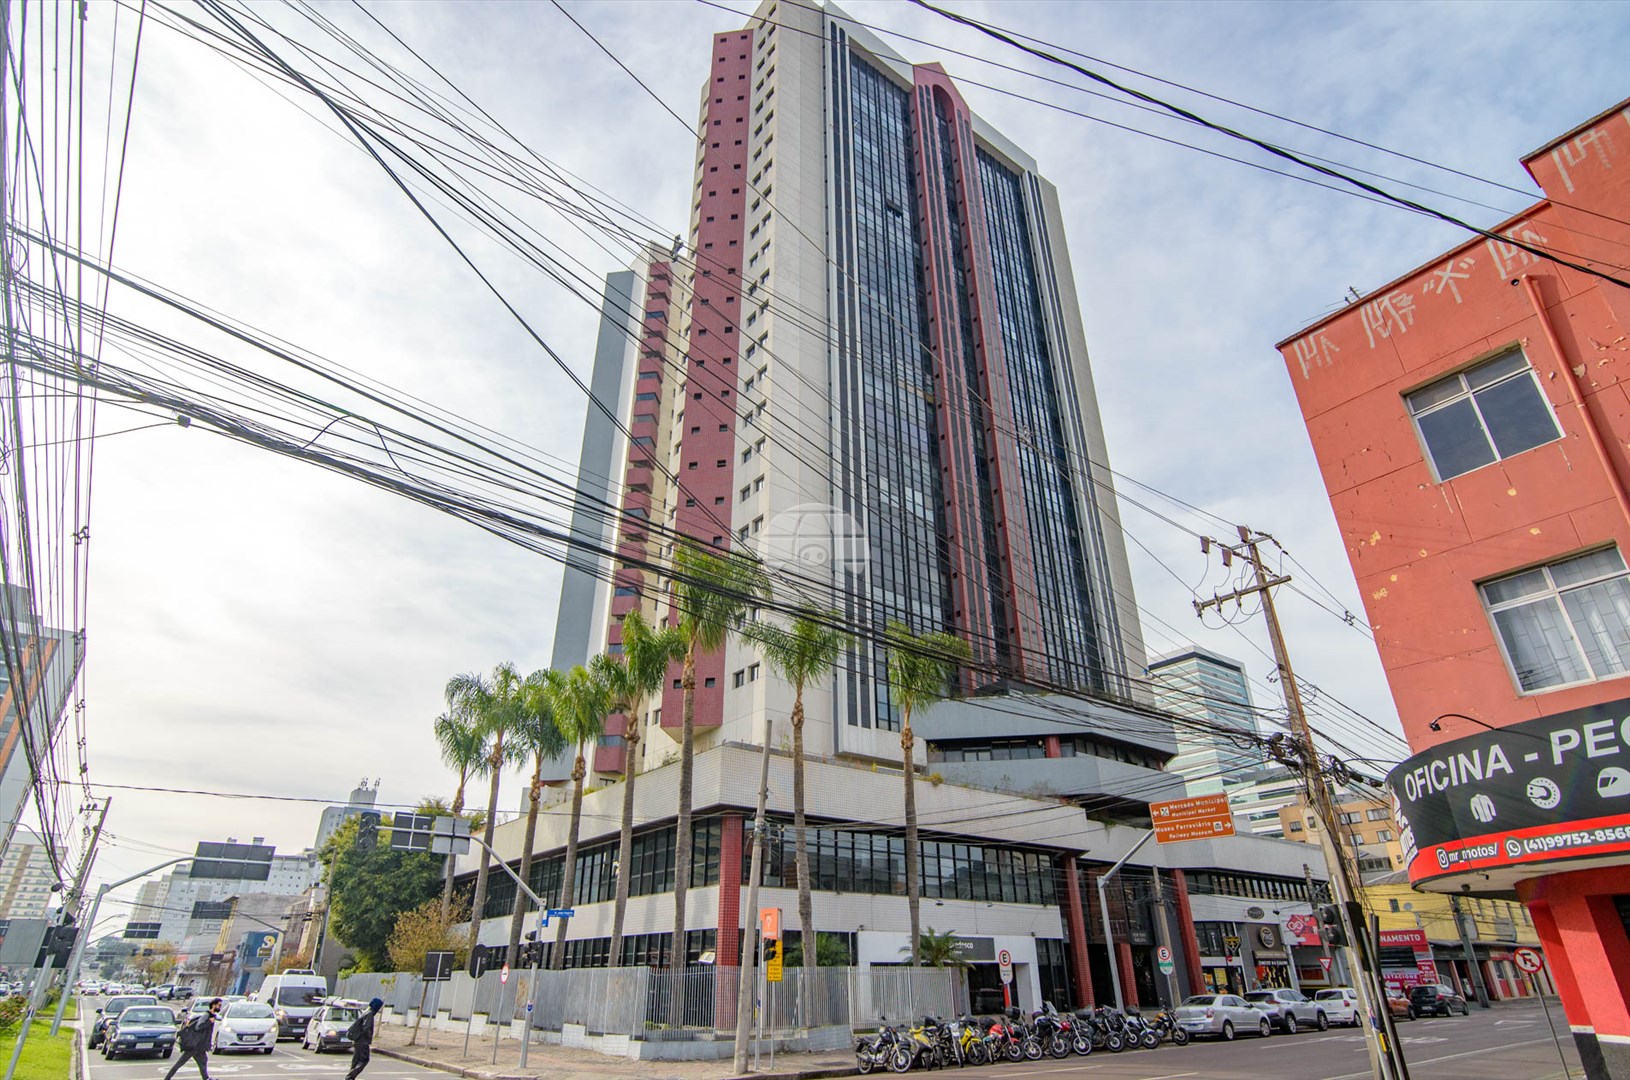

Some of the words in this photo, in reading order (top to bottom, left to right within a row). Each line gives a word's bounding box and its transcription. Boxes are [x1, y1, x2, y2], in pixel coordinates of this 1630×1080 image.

[1404, 743, 1513, 802] OFICINA
[1196, 797, 1226, 805] Municipal
[1176, 822, 1211, 830] Ferroviário
